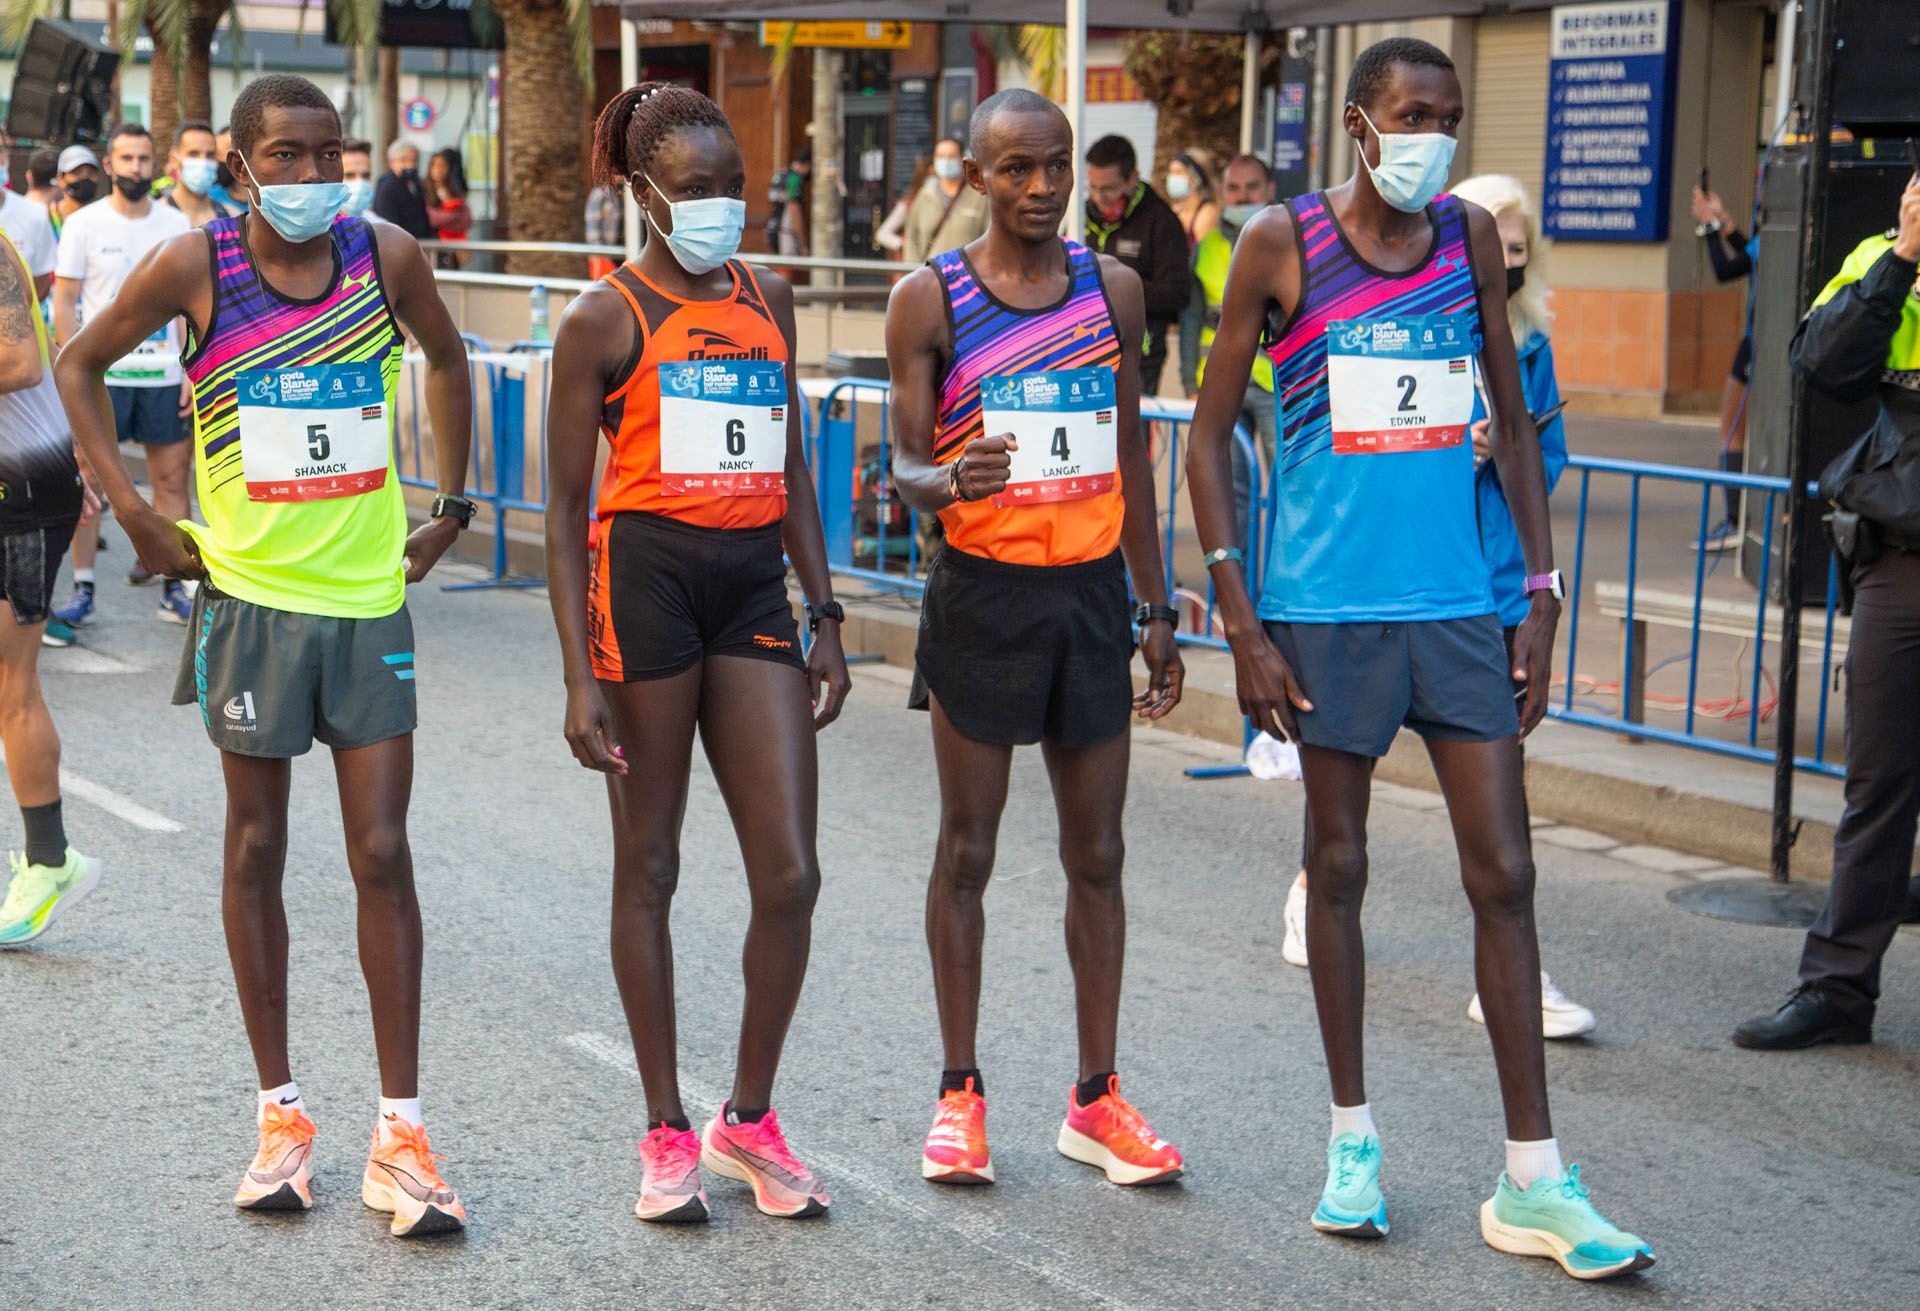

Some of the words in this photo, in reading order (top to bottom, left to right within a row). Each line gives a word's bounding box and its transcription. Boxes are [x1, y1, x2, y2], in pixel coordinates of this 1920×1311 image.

[1562, 12, 1656, 30] REFORMAS
[1561, 33, 1656, 50] INTEGRALES
[1566, 61, 1626, 81] PINTURA
[1582, 147, 1641, 163] GENERAL
[1561, 166, 1652, 185] ELECTRICIDAD
[1372, 321, 1397, 331] costa
[1373, 329, 1410, 340] blanca
[703, 365, 726, 373] costa
[280, 371, 305, 380] costa
[703, 373, 738, 382] blanca
[1023, 376, 1047, 385] costa
[280, 378, 319, 389] blanca
[1023, 382, 1060, 393] blanca
[1397, 374, 1418, 412] 2
[1391, 416, 1426, 427] EDWIN
[306, 424, 330, 461] 5
[726, 419, 746, 457] 6
[1050, 426, 1071, 461] 4
[294, 463, 347, 477] SHAMACK
[719, 461, 754, 470] NANCY
[1042, 465, 1081, 477] LANGAT
